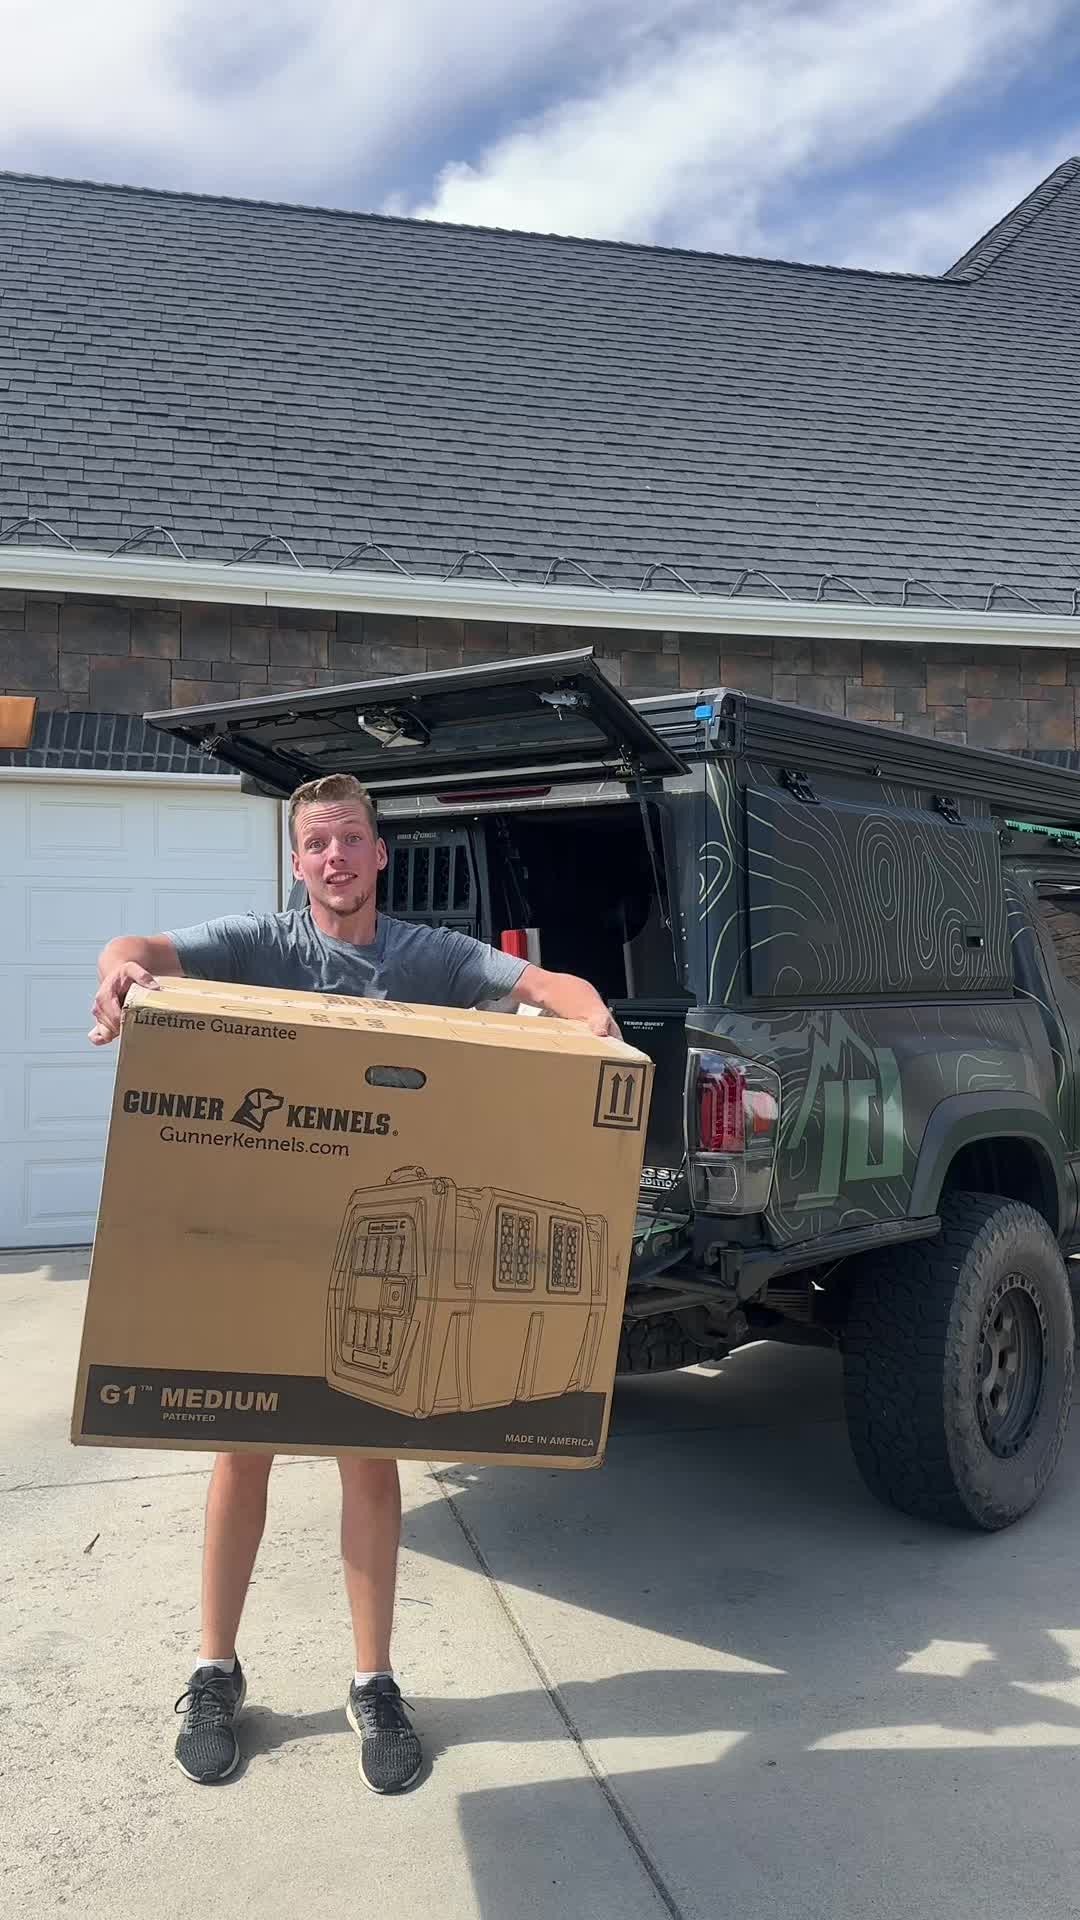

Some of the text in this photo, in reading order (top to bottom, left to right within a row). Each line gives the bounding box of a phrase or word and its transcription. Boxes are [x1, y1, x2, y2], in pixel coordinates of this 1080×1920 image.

[133, 1010, 206, 1031] Lifetime
[210, 1018, 298, 1041] Guarantee
[122, 1089, 225, 1121] GUNNER
[159, 1125, 350, 1157] GunnerKennels.com
[160, 1387, 279, 1412] MEDIUM
[162, 1412, 216, 1423] PATENTED
[504, 1433, 594, 1447] MADE IN AMERICA
